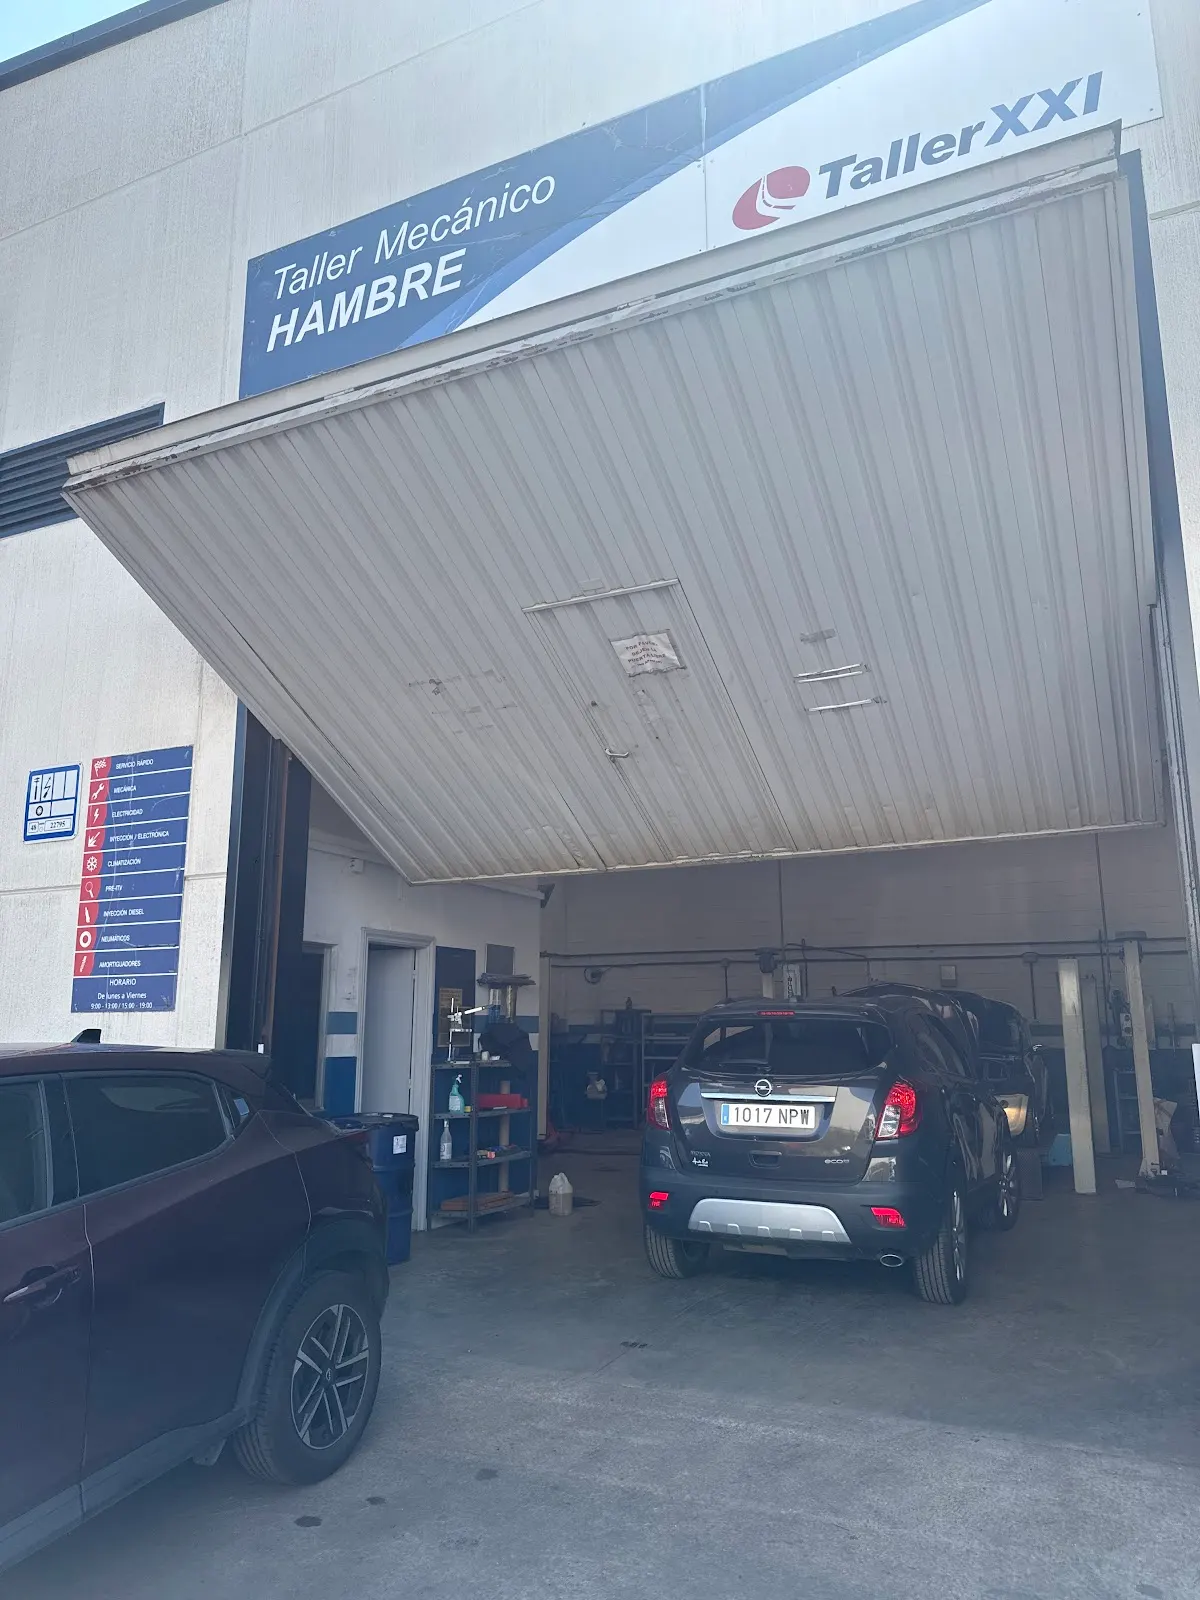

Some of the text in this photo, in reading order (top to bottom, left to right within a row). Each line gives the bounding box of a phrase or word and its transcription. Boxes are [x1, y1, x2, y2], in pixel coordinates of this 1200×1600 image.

[819, 70, 1103, 199] TallerXXI
[273, 175, 556, 300] Taller Mecánico
[266, 248, 467, 353] HAMBRE
[116, 761, 135, 769] SERVICIO
[112, 809, 143, 818] ELECTRICIDAD
[110, 833, 133, 842] INYECCIÓN
[138, 830, 169, 840] ELECTRÓNICA
[108, 857, 141, 867] CLIMATIZACIÓN
[103, 909, 127, 917] INYECCIÓN
[101, 934, 130, 942] NEUMÁTICOS
[99, 960, 141, 968] AMORTIGUADORES
[110, 978, 136, 986] HORARIO
[735, 1107, 809, 1125] 1017 NPW
